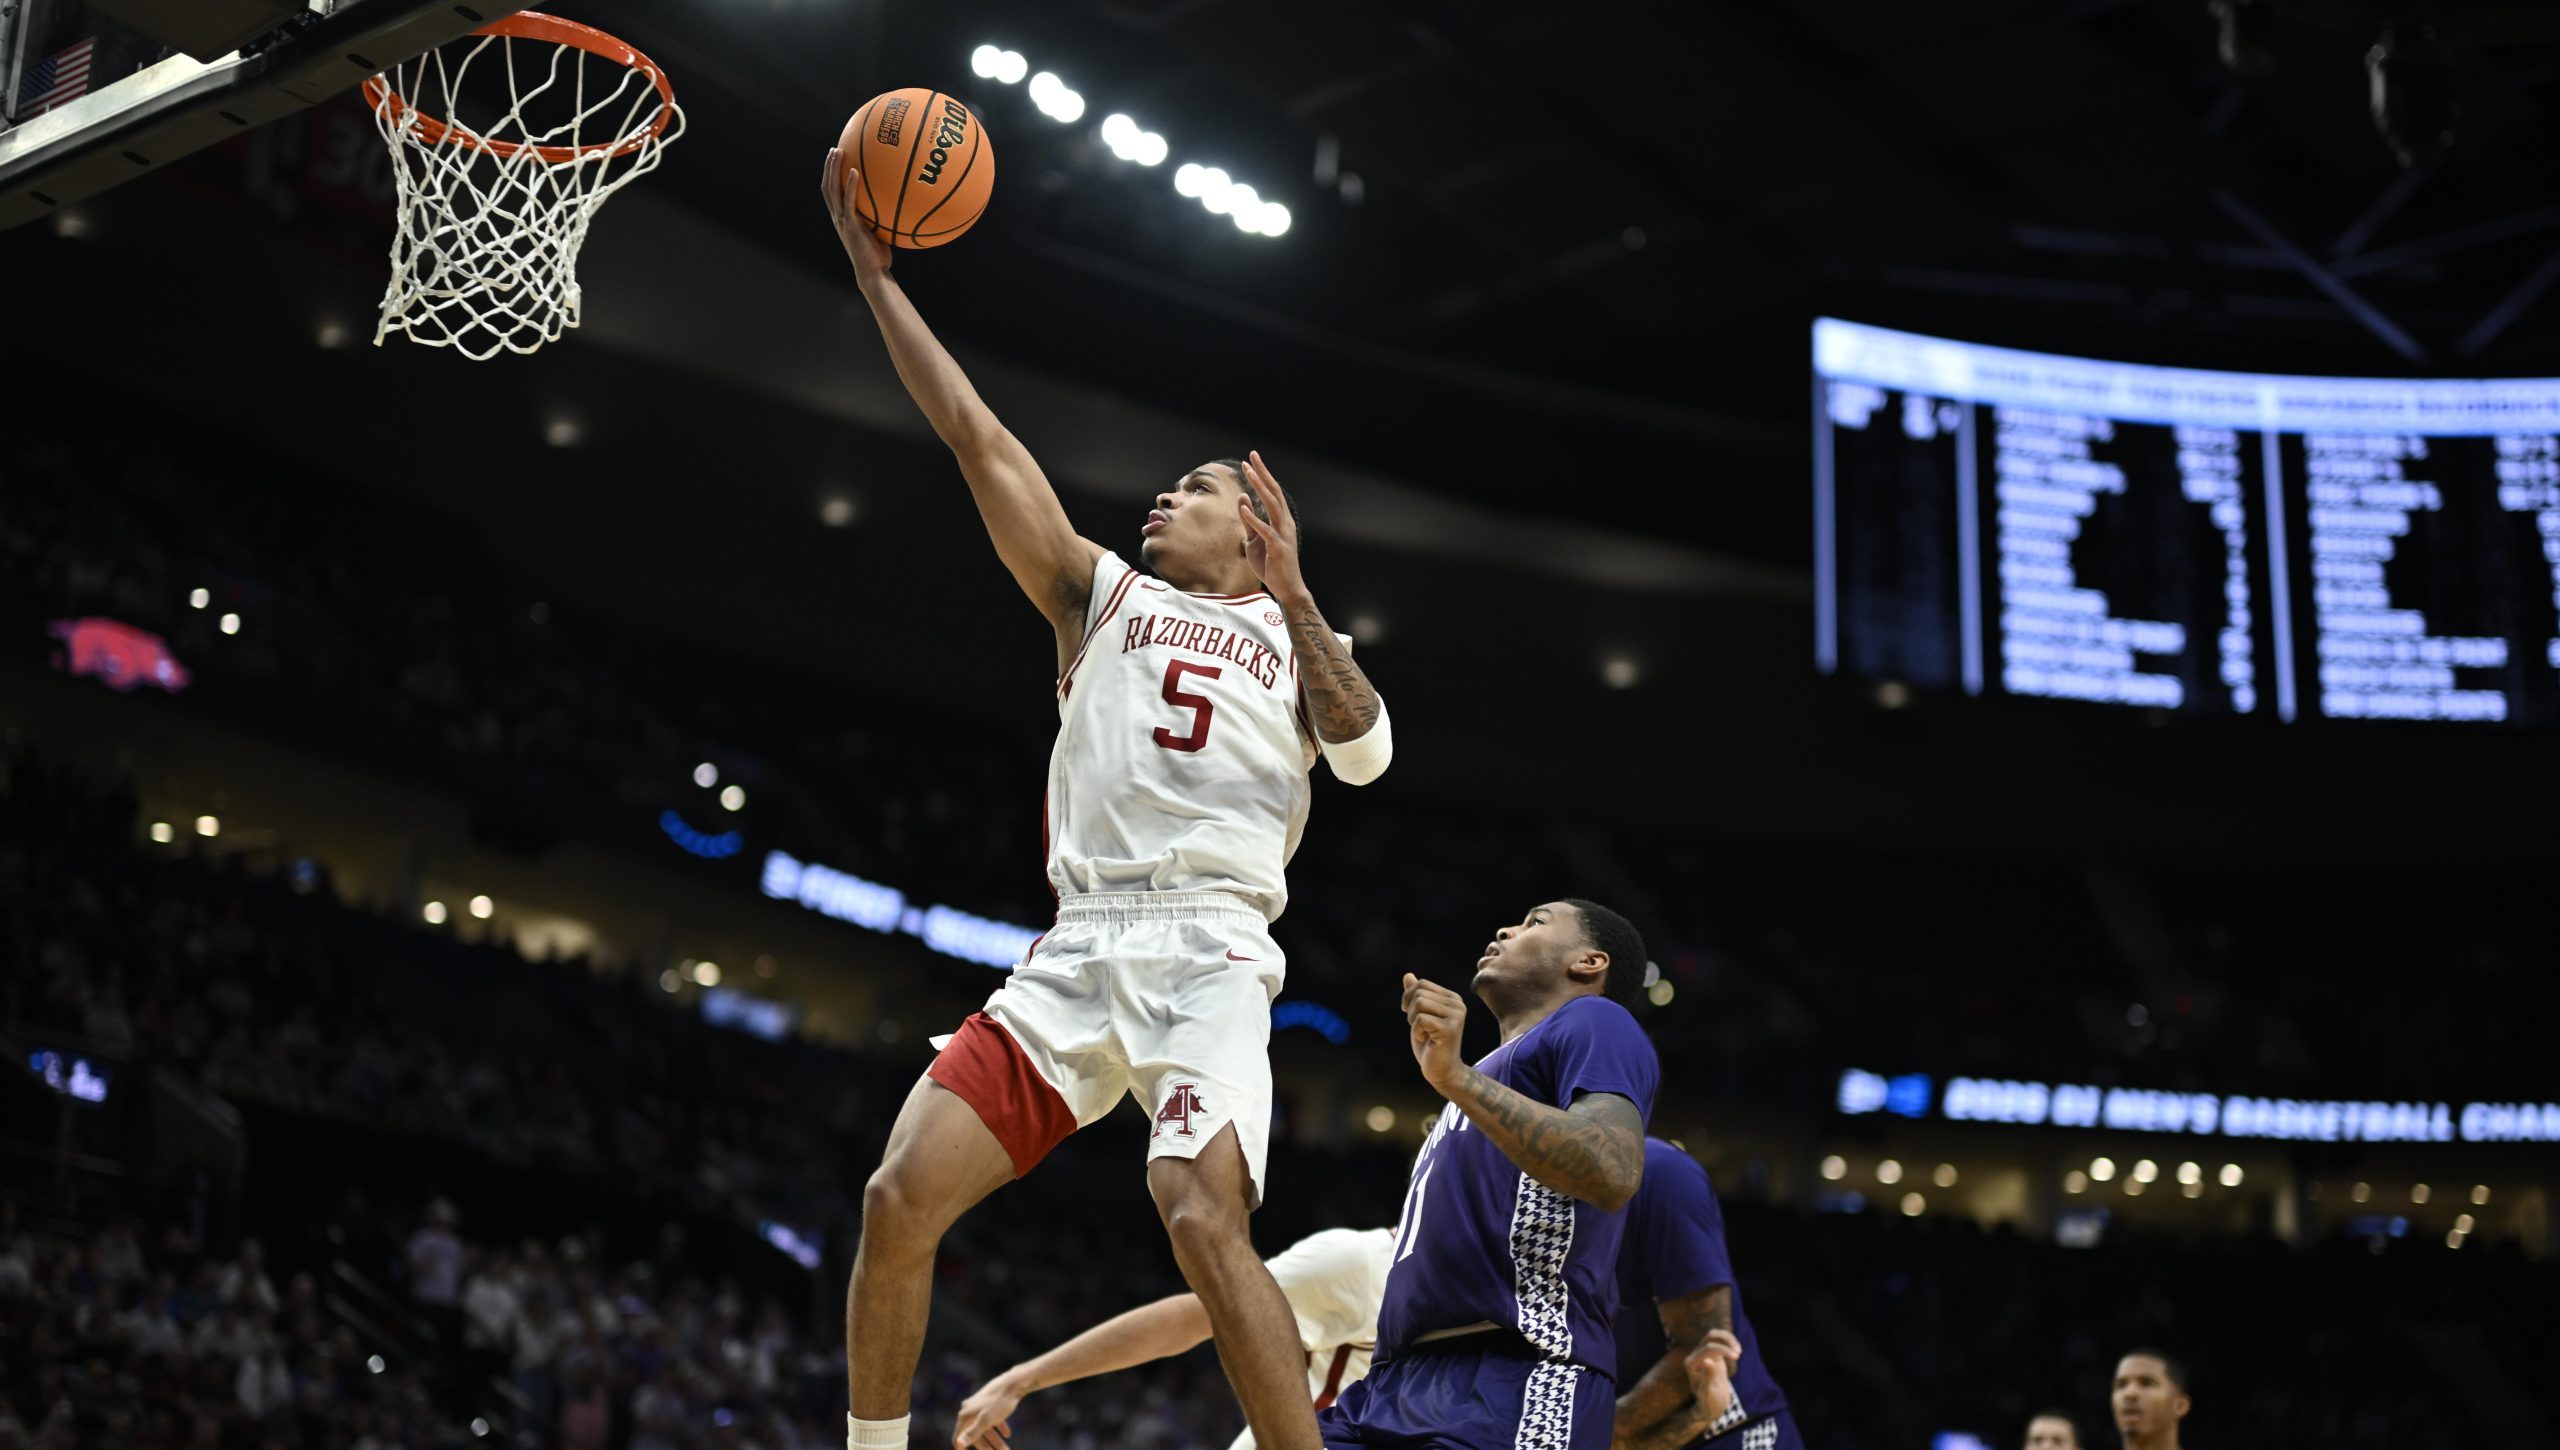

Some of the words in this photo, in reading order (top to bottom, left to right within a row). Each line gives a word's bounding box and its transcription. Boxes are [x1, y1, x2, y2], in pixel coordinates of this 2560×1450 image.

[880, 106, 897, 145] MADNESS
[918, 99, 968, 186] Wilson
[1264, 612, 1284, 626] SEC
[1122, 614, 1281, 690] RAZORBACKS
[1153, 659, 1222, 752] 5
[2222, 1096, 2454, 1142] BASKETBALL
